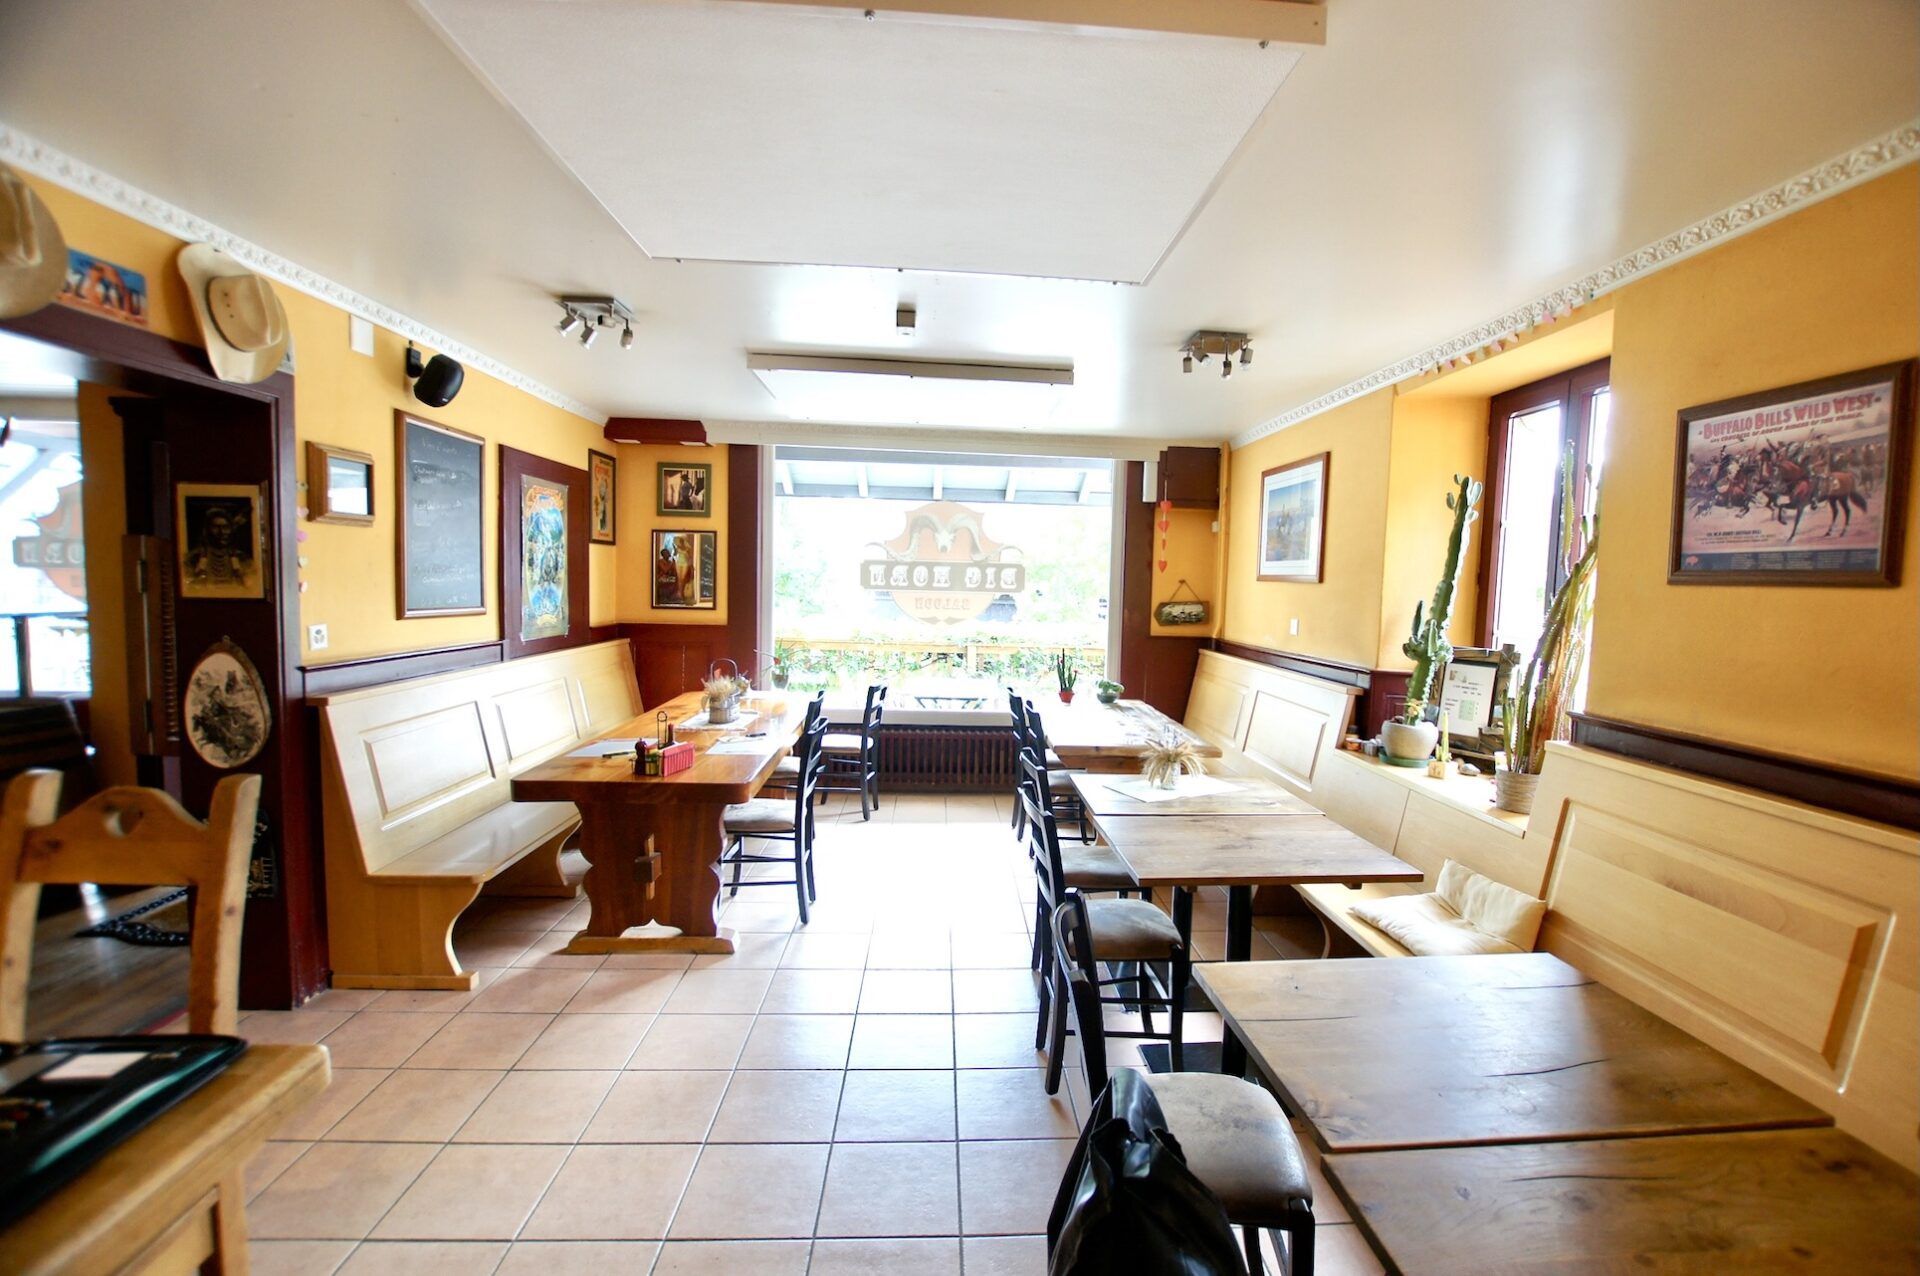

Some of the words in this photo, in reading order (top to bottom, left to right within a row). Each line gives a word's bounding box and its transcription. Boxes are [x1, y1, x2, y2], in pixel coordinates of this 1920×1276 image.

[1703, 418, 1753, 439] BUFFALO
[1793, 402, 1831, 419] WILD
[1833, 393, 1875, 412] WEST
